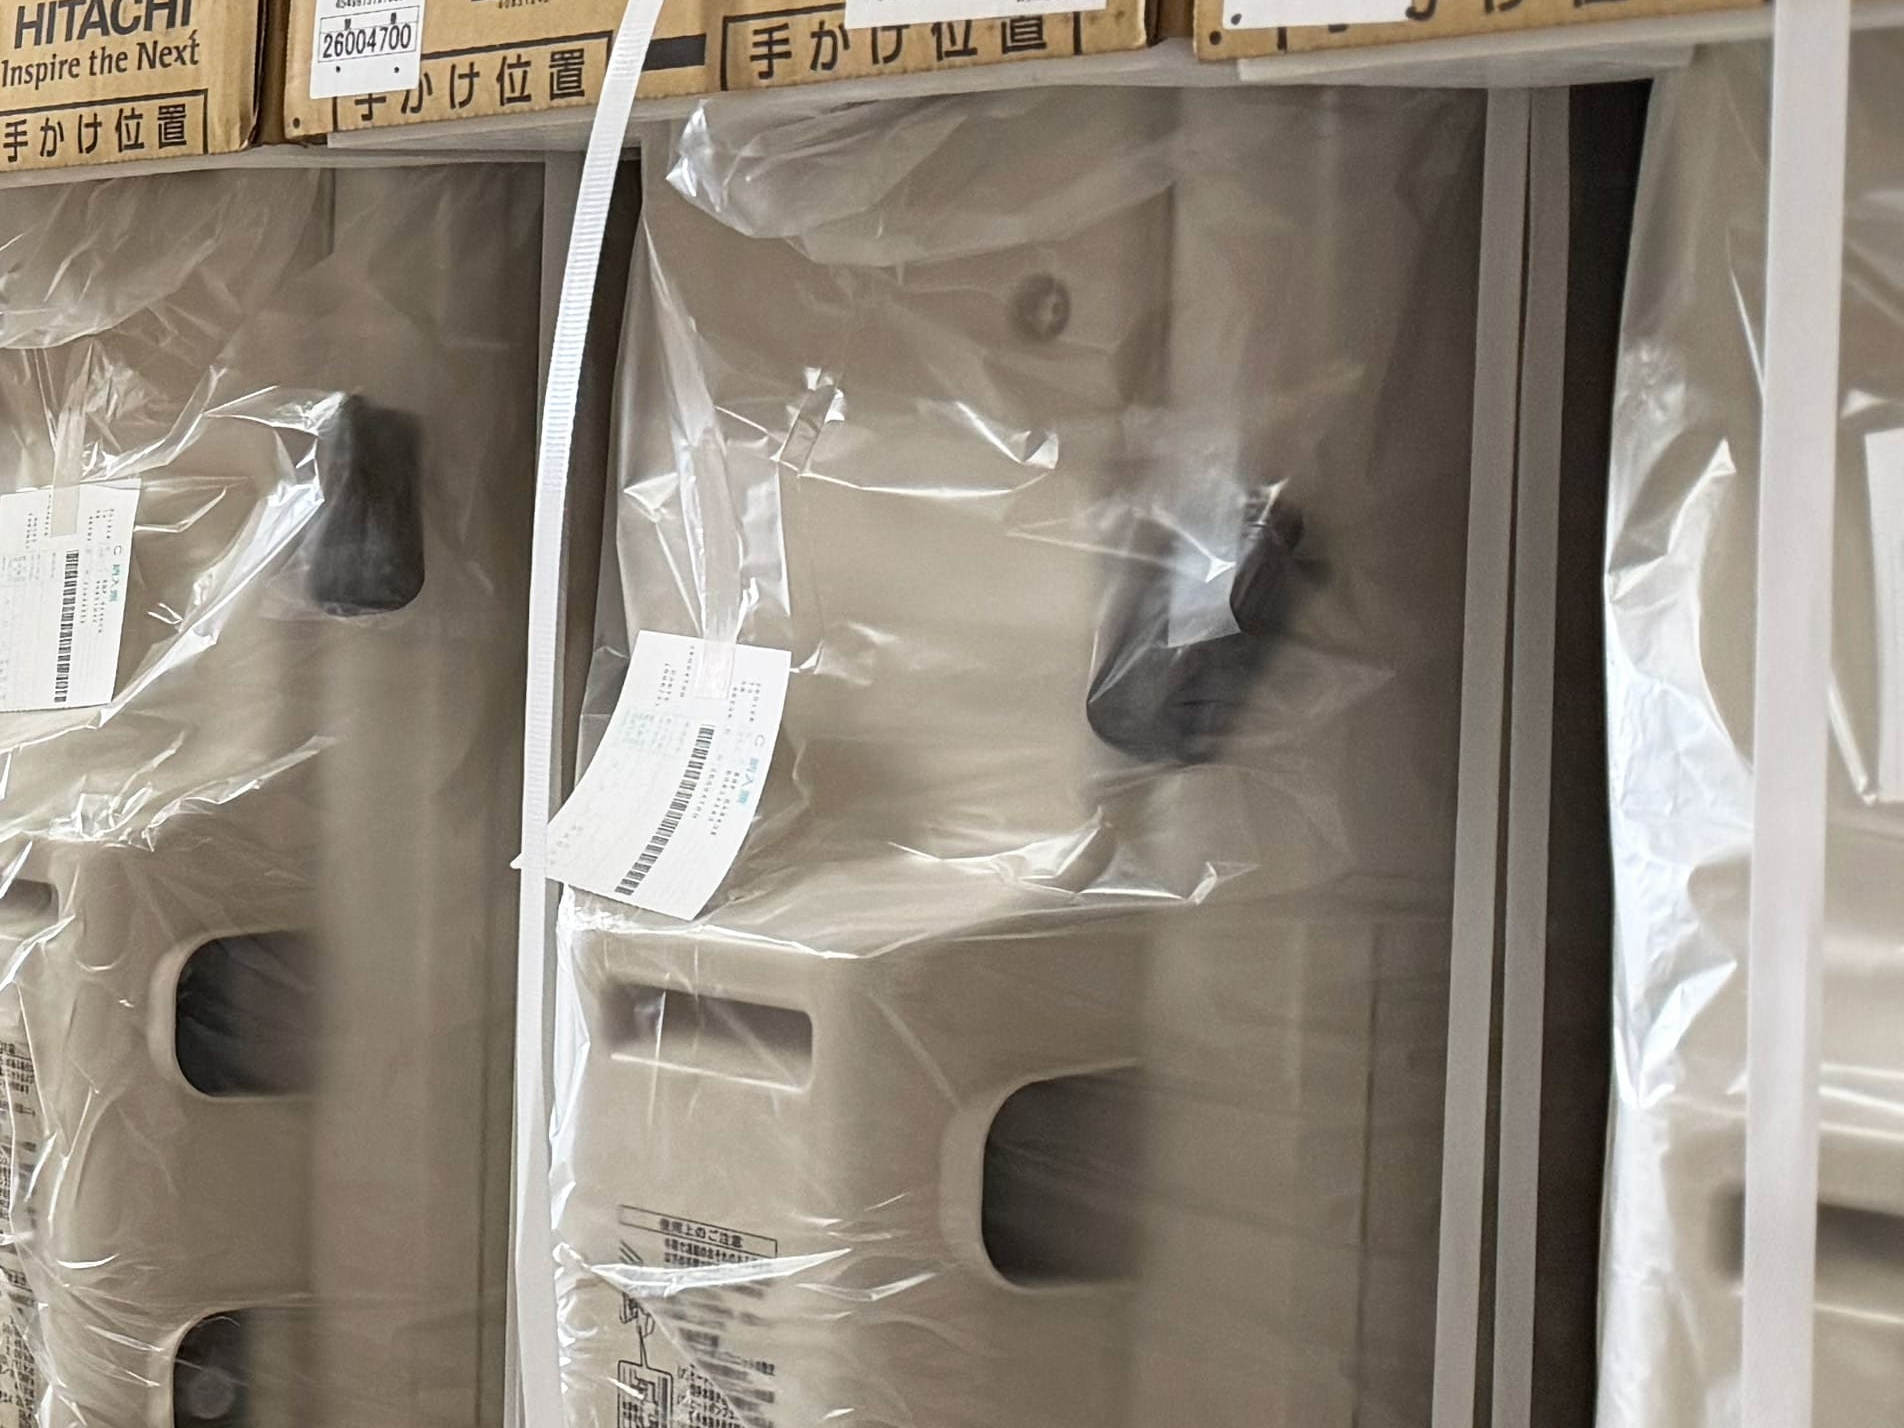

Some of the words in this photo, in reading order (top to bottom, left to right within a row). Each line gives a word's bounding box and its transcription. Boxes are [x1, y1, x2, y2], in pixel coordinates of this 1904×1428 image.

[1, 52, 80, 93] Inspire
[88, 43, 130, 79] the
[137, 29, 200, 70] Next
[323, 23, 412, 59] 26004700
[1, 104, 188, 164] 手かけ位置
